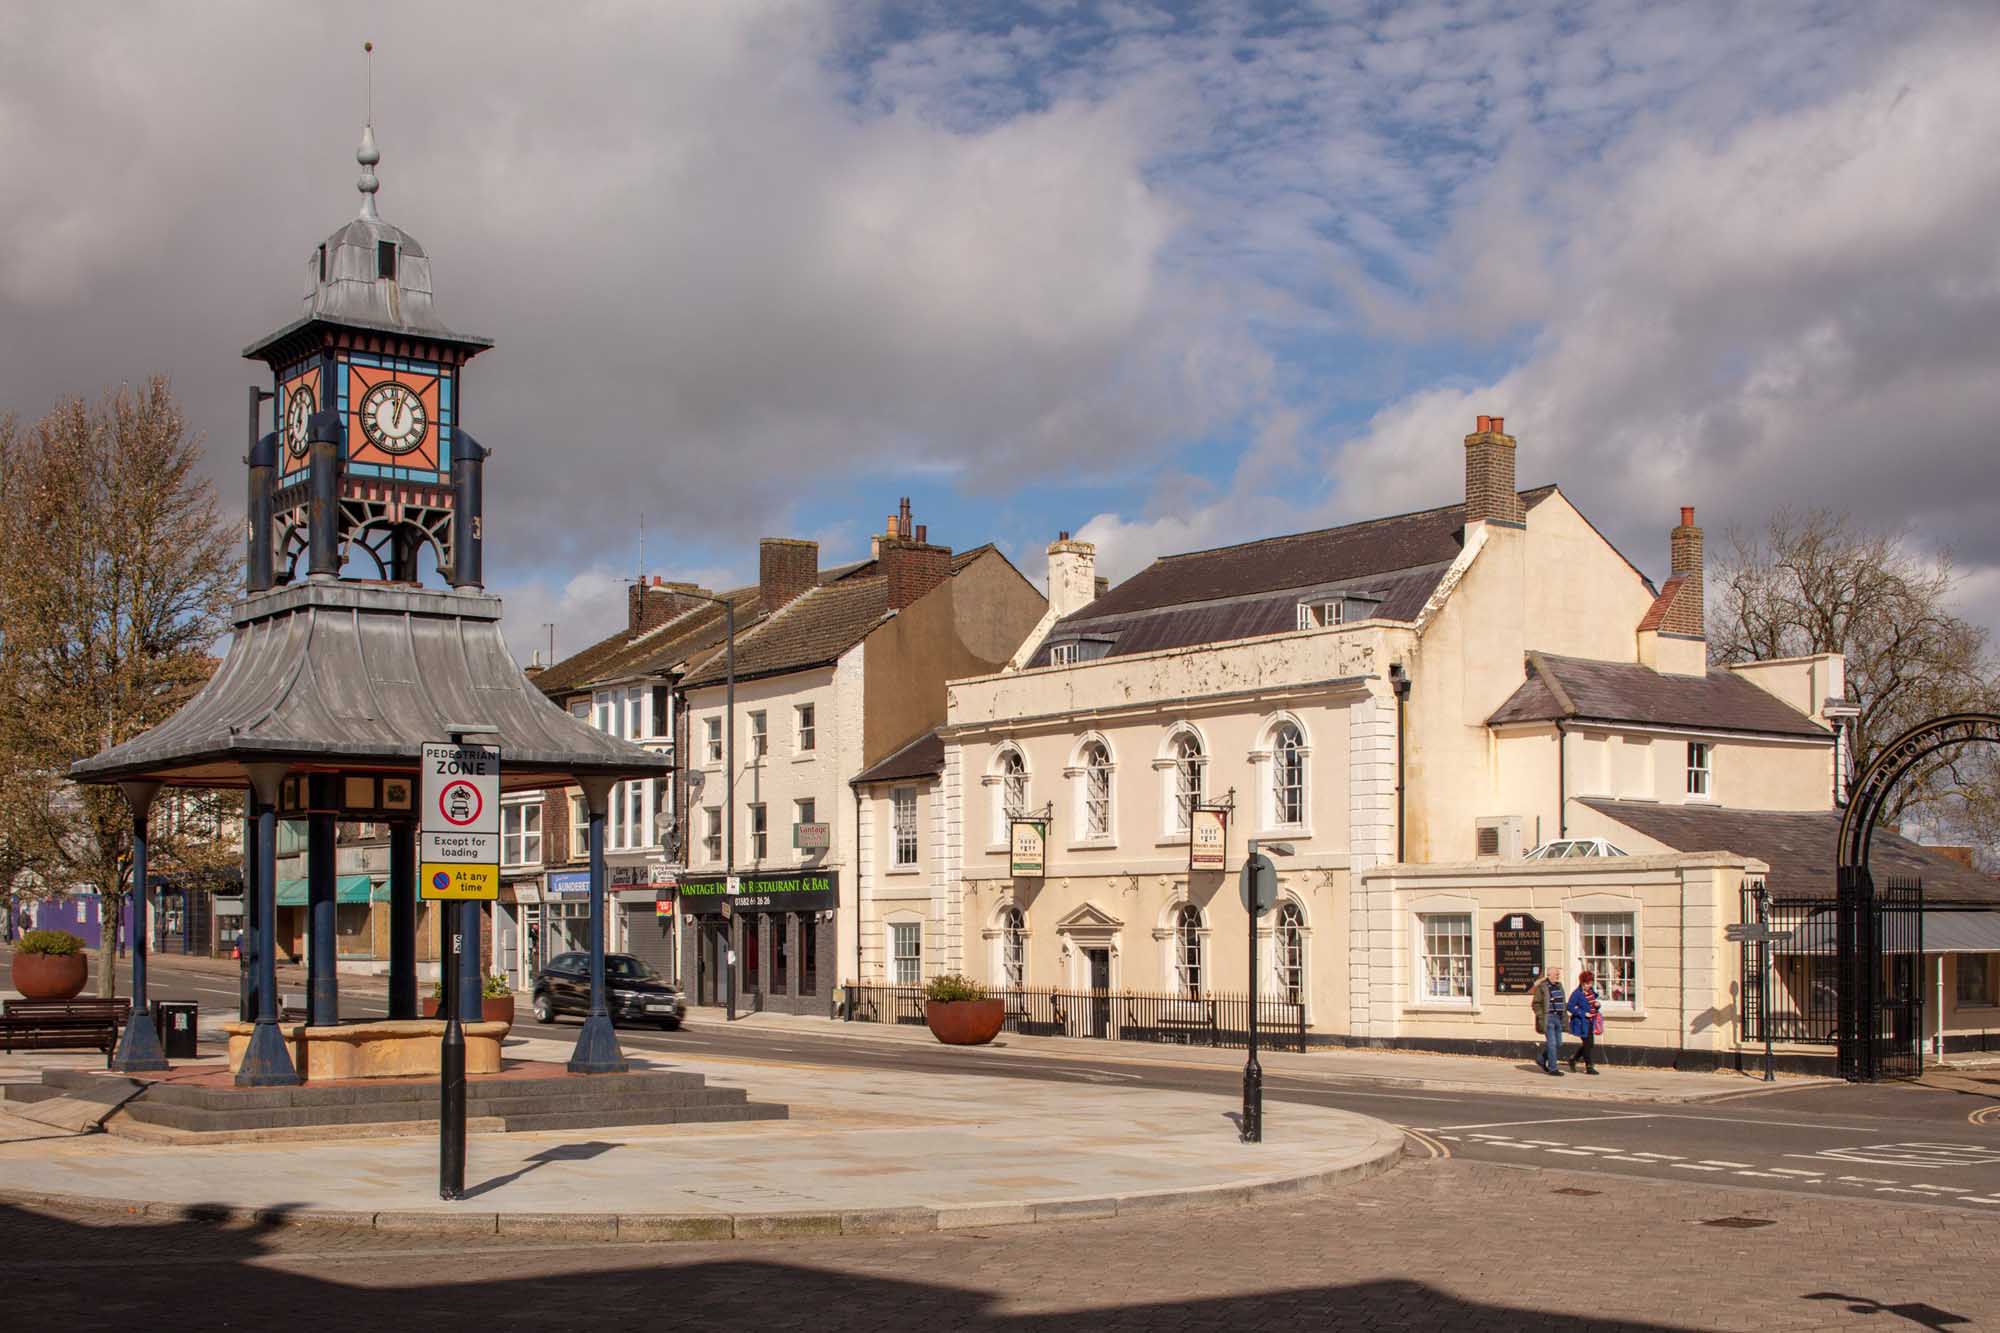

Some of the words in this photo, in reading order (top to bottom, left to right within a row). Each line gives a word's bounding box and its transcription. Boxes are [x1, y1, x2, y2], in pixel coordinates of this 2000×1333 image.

[426, 749, 496, 760] PEDESTRIAN
[436, 761, 486, 775] ZONE
[434, 836, 469, 847] Except
[472, 837, 486, 846] for
[442, 848, 478, 858] loading
[456, 872, 467, 880] At
[470, 873, 488, 882] any
[461, 883, 482, 891] time
[553, 879, 591, 892] LAUNDERET
[680, 883, 714, 896] VANTAGE
[716, 881, 746, 895] INN
[749, 880, 800, 893] RESTAURANT
[802, 877, 810, 890] &
[812, 877, 830, 891] BAR
